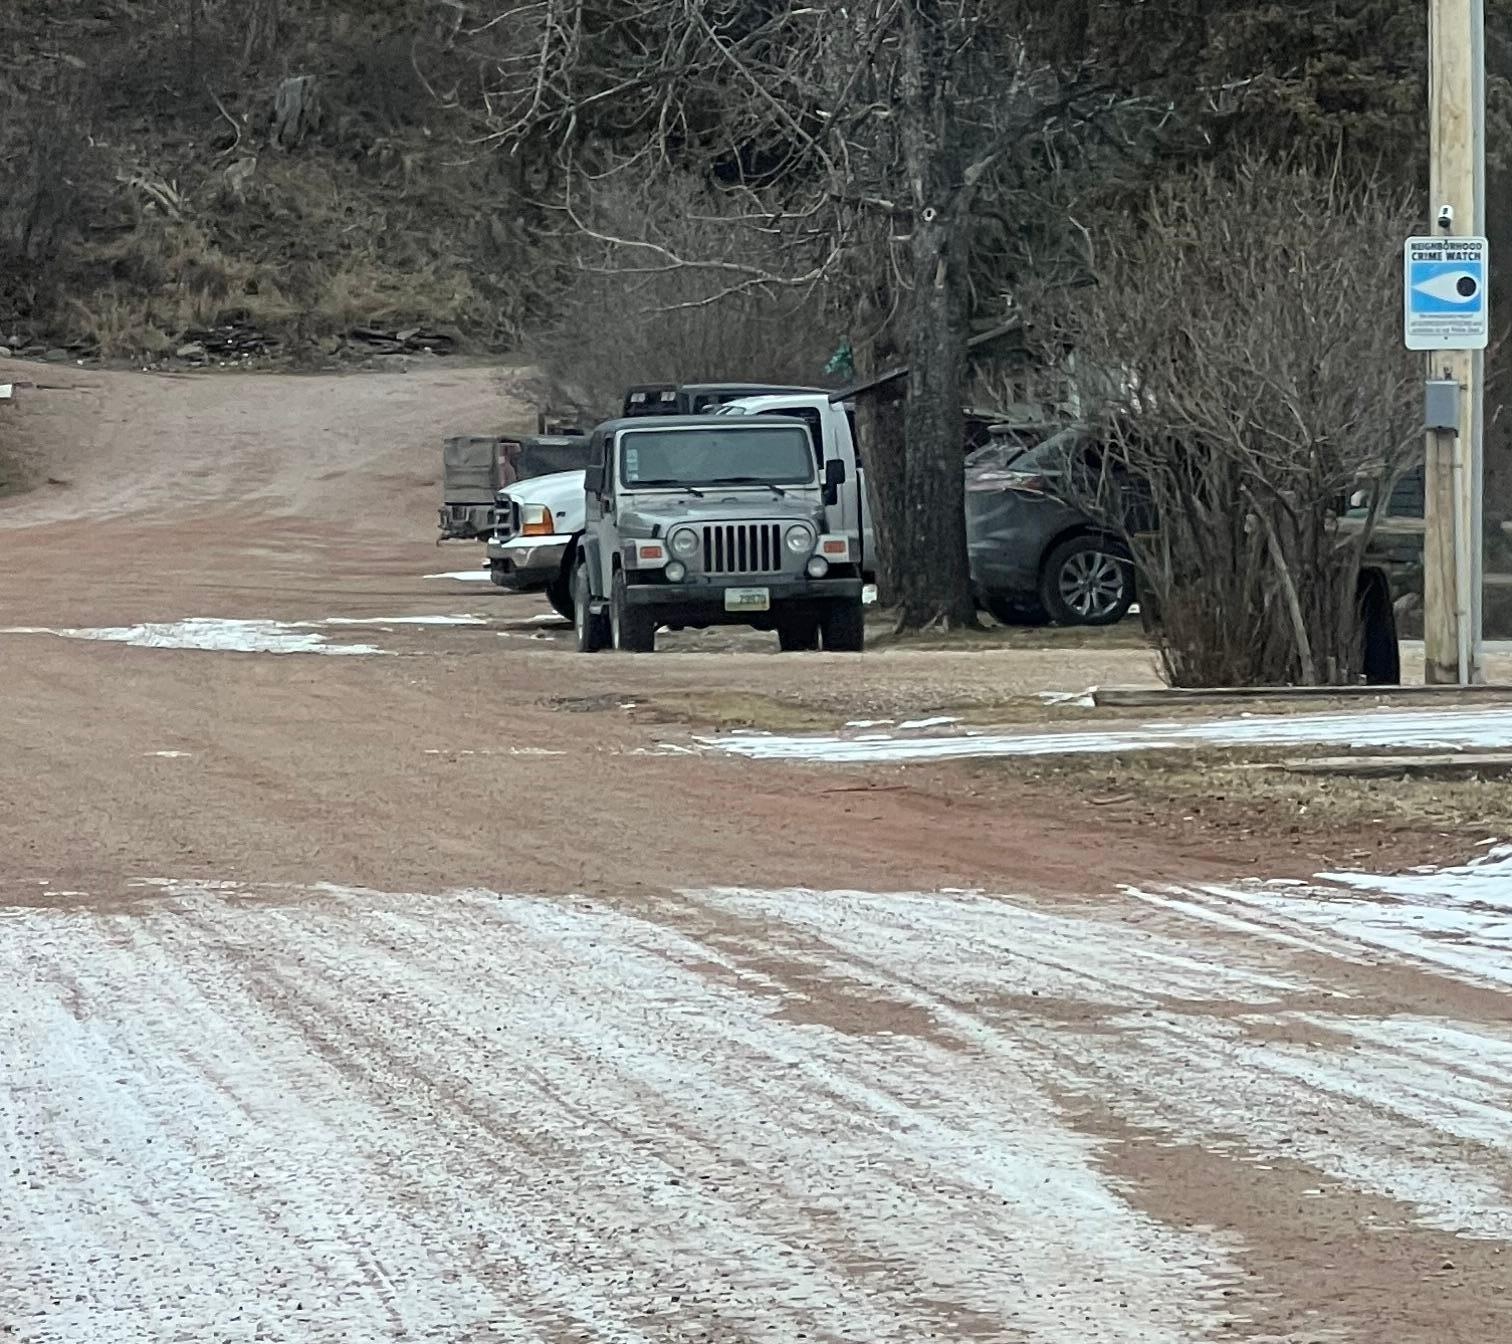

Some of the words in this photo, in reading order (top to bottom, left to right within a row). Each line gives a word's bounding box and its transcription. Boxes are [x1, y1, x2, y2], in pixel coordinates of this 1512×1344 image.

[1411, 242, 1482, 251] NEIGHBORHOOD
[1412, 251, 1442, 261] CRIME
[1446, 251, 1481, 261] WATCH
